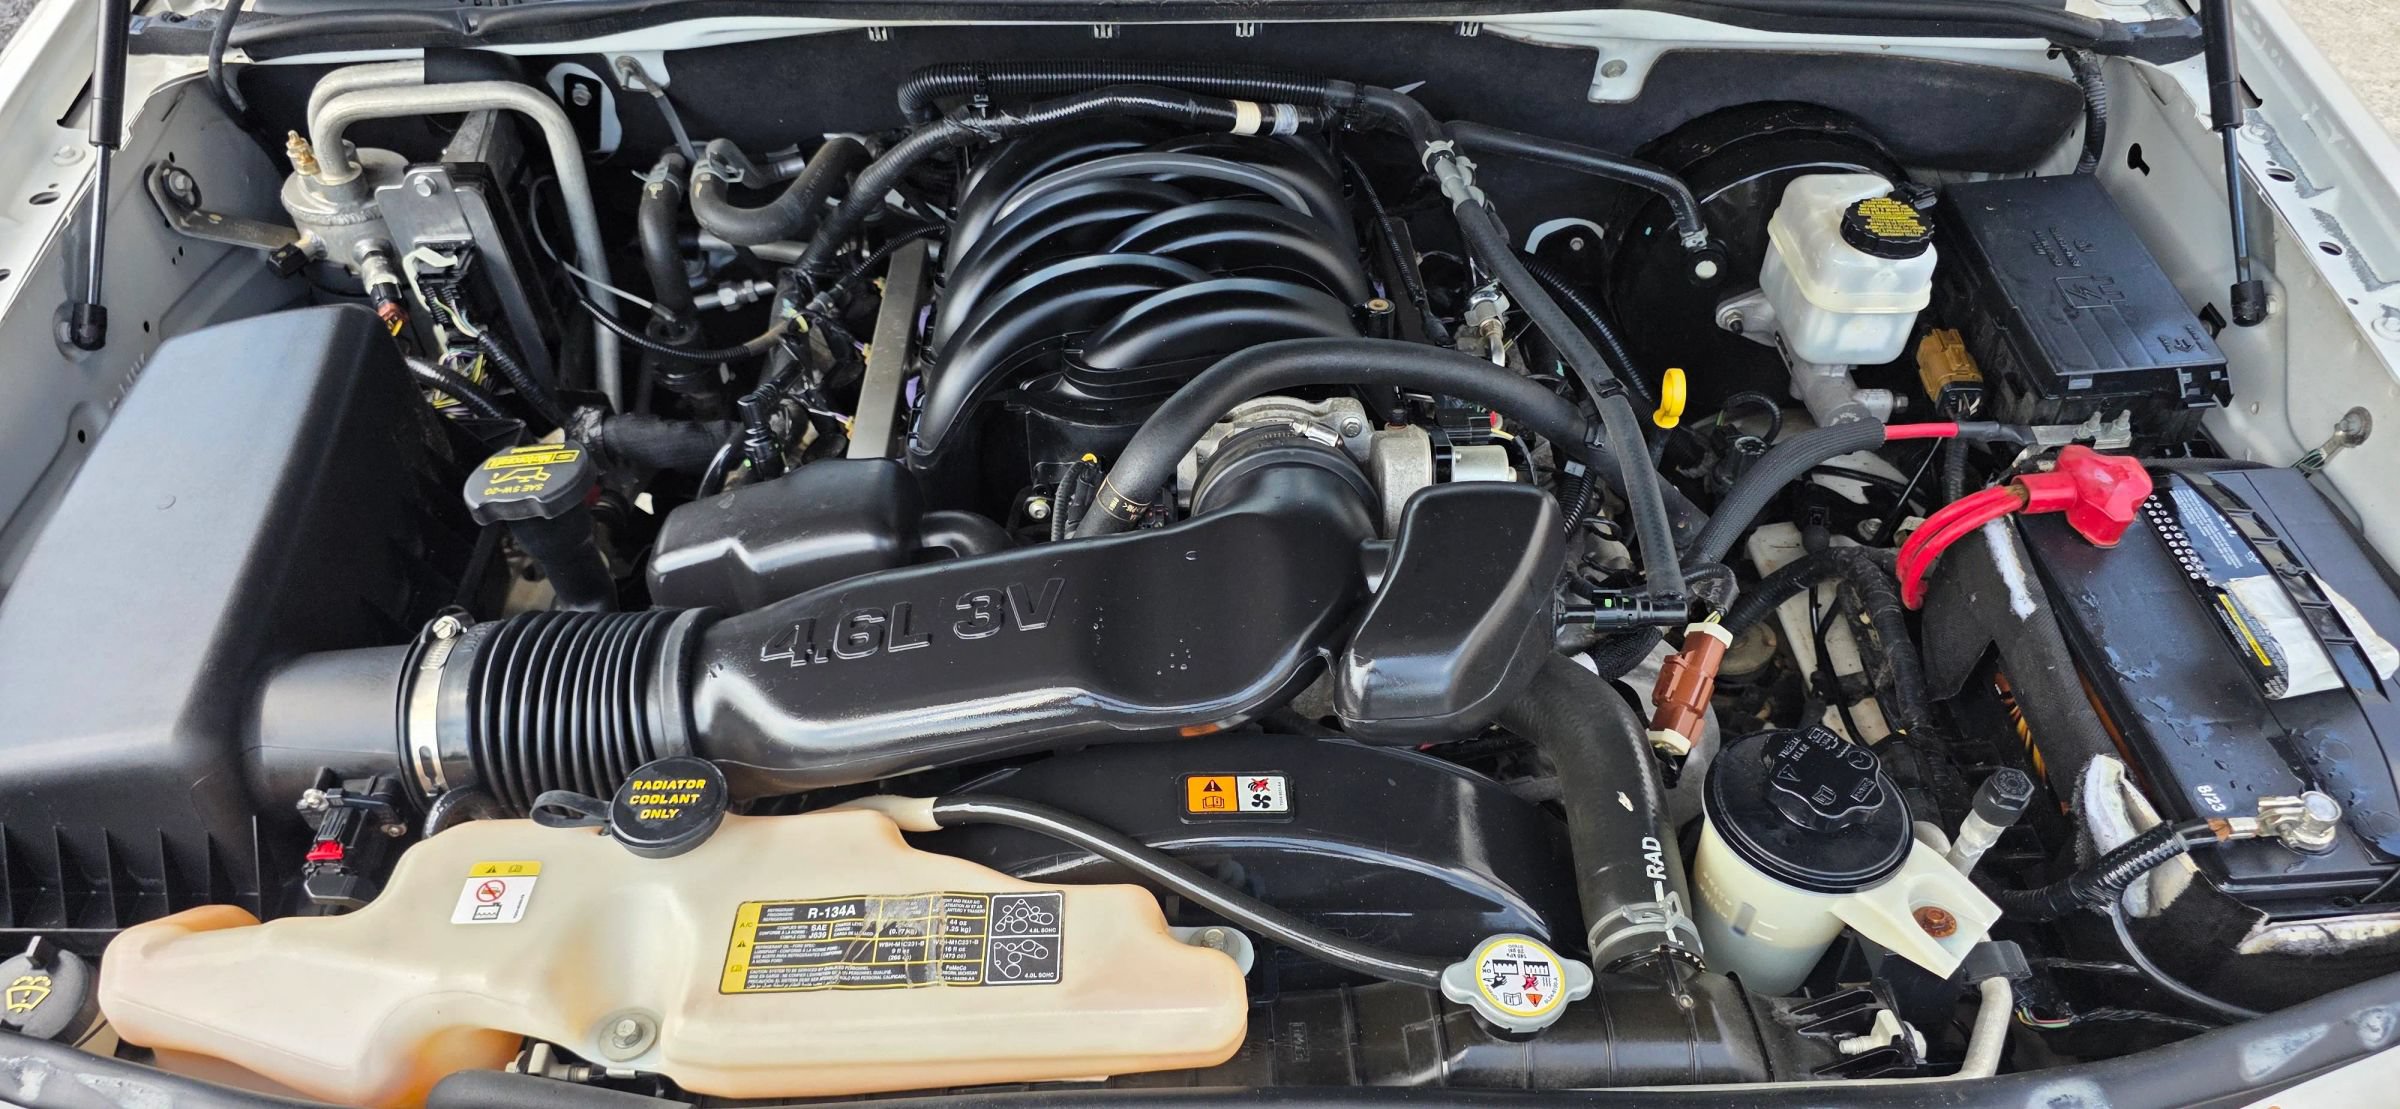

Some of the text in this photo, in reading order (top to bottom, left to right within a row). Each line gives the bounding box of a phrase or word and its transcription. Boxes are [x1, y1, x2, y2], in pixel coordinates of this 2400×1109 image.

[521, 483, 544, 492] SAE
[760, 578, 1065, 667] 4.6L 3V
[632, 779, 706, 791] RADIATOR
[629, 793, 700, 805] COOLANT
[2197, 785, 2227, 811] 8/23
[640, 808, 679, 820] ONLY
[1642, 836, 1667, 880] RAD
[807, 904, 856, 919] R-134A
